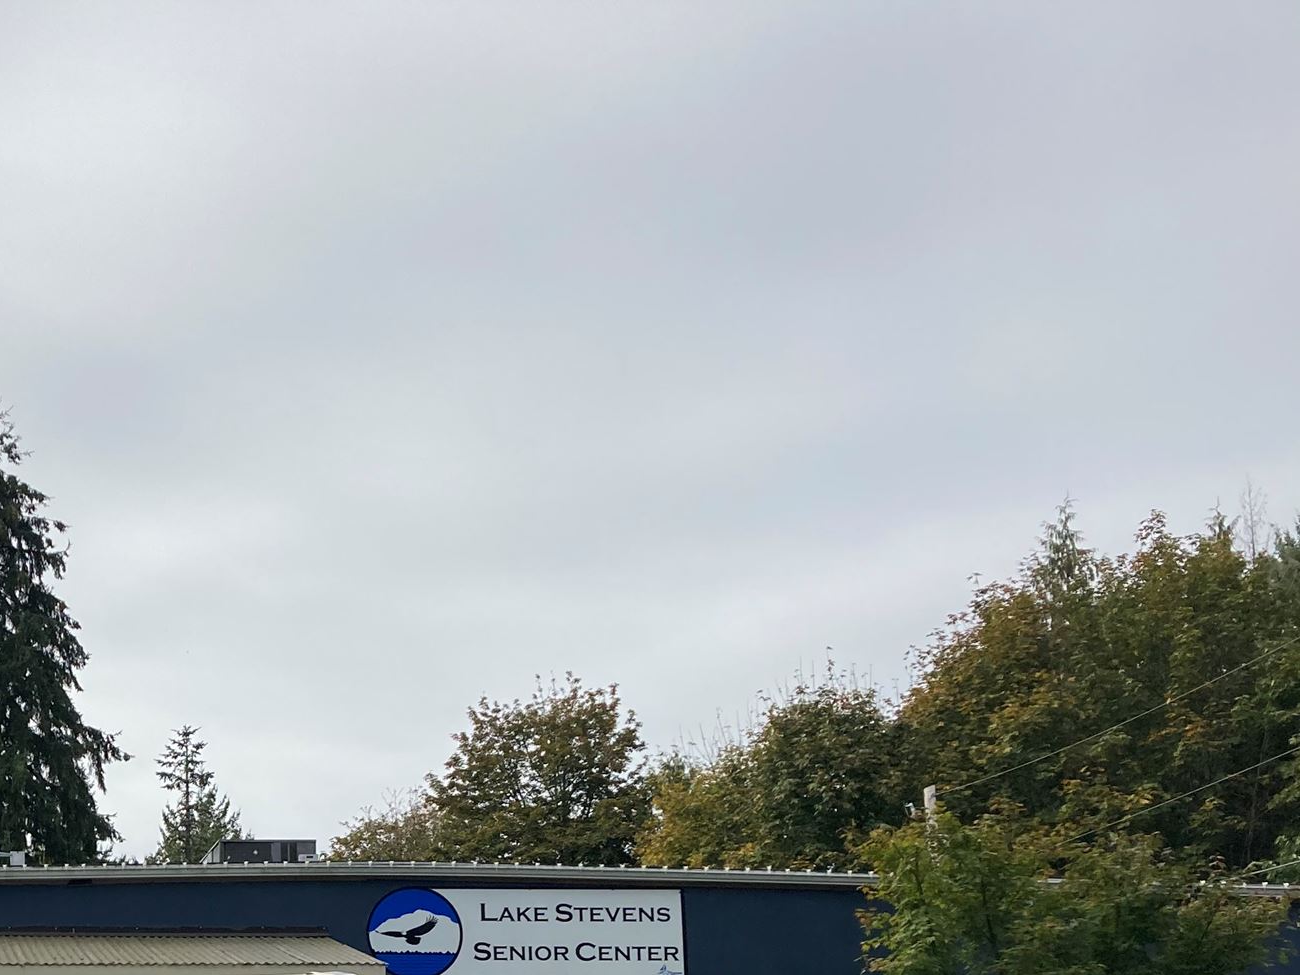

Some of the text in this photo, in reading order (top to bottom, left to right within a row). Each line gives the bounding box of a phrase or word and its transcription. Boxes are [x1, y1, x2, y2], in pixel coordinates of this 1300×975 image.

[479, 902, 671, 922] LAKE STEVENS
[473, 942, 680, 962] SENIOR CENTER
